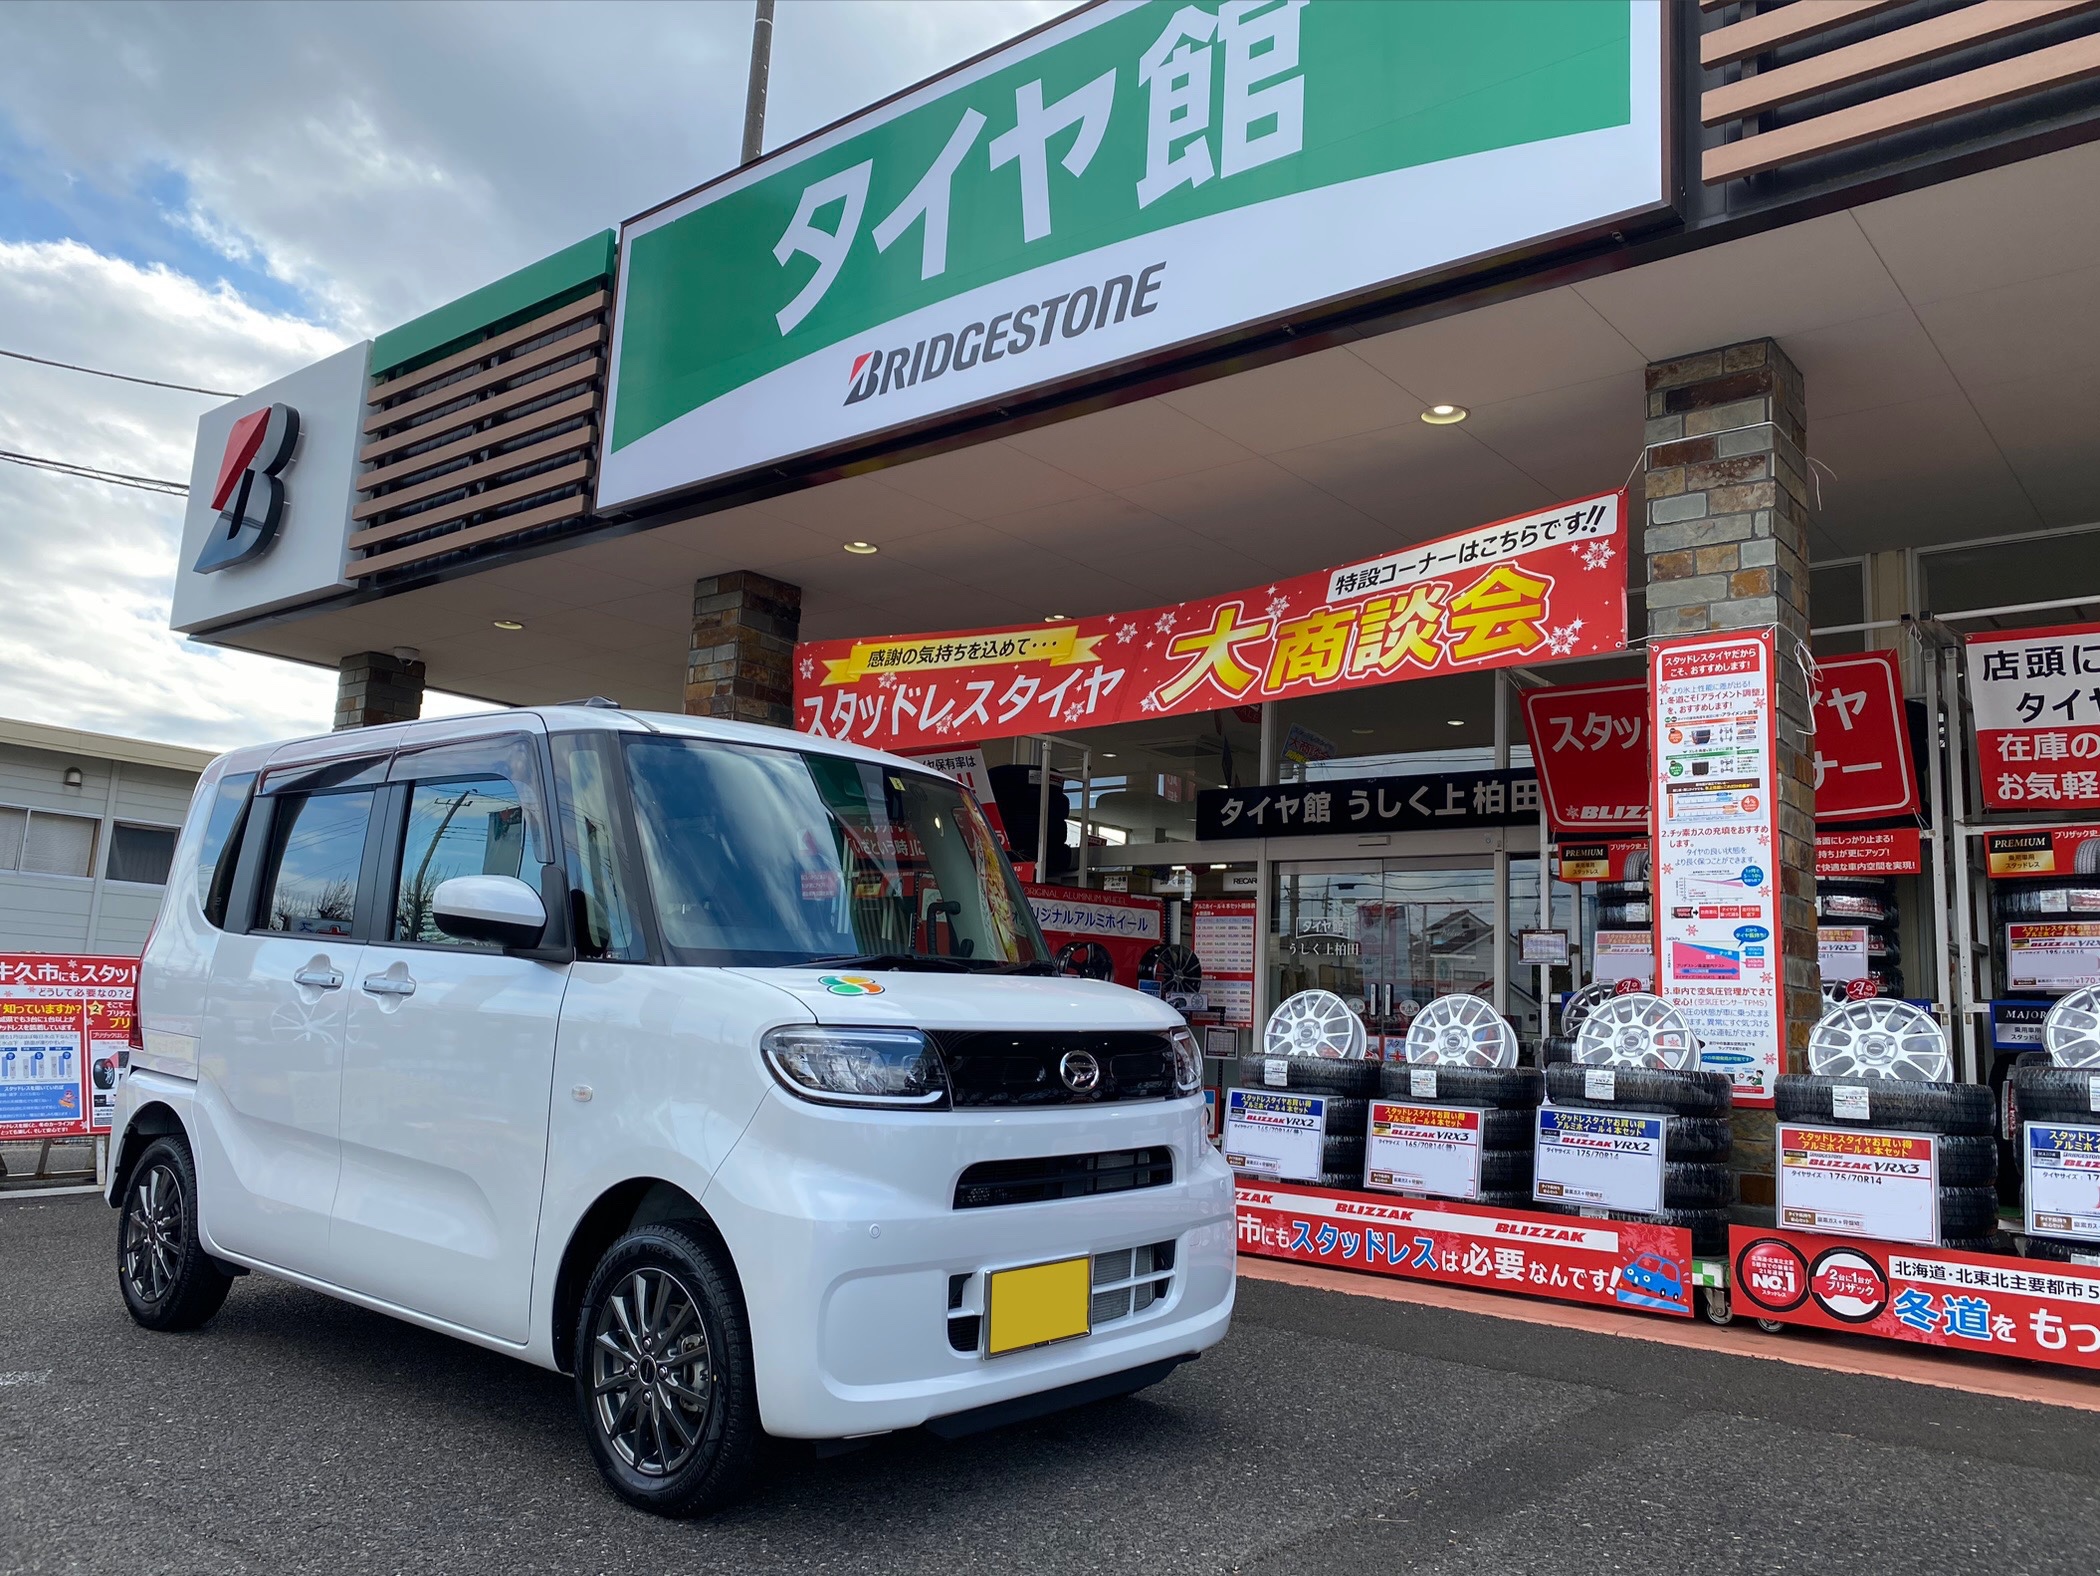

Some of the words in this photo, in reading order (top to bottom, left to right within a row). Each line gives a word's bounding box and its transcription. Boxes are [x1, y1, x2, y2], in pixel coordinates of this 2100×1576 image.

[772, 0, 1304, 337] タイヤ館
[843, 261, 1167, 406] BRIDGESTONE
[1158, 562, 1548, 708] 大商談会
[1665, 648, 1756, 666] スタッドレスタイヤだから
[804, 665, 1125, 740] スタッドレスタイヤ
[1549, 712, 1641, 753] スタッ
[1221, 791, 1332, 826] タイヤ館
[1348, 779, 1541, 820] うしく上柏田
[1994, 837, 2046, 849] PREMIUM
[1565, 848, 1604, 857] PREMIUM
[1302, 919, 1344, 933] タイヤ館
[1289, 942, 1360, 956] うしく上柏田
[1247, 1115, 1285, 1124] BLIZZAK
[1286, 1117, 1314, 1127] VRX2
[1391, 1129, 1435, 1138] BLIZZAK
[1436, 1131, 1469, 1141] VRX3
[1798, 1132, 1913, 1150] スタッドレスタイヤお買い得
[1562, 1137, 1612, 1148] BLIZZAK
[1613, 1140, 1650, 1151] VRX2
[1808, 1158, 1872, 1171] BLIZZAK
[1874, 1161, 1920, 1174] VRX3
[1828, 1172, 1882, 1186] 175/70R14
[1335, 1203, 1415, 1221] BLIZZAK
[1495, 1223, 1586, 1242] BLIZZAK
[1752, 1271, 1796, 1292] NO.1
[1829, 1268, 1873, 1284] 2台に1台が
[1826, 1280, 1874, 1296] ブリザック
